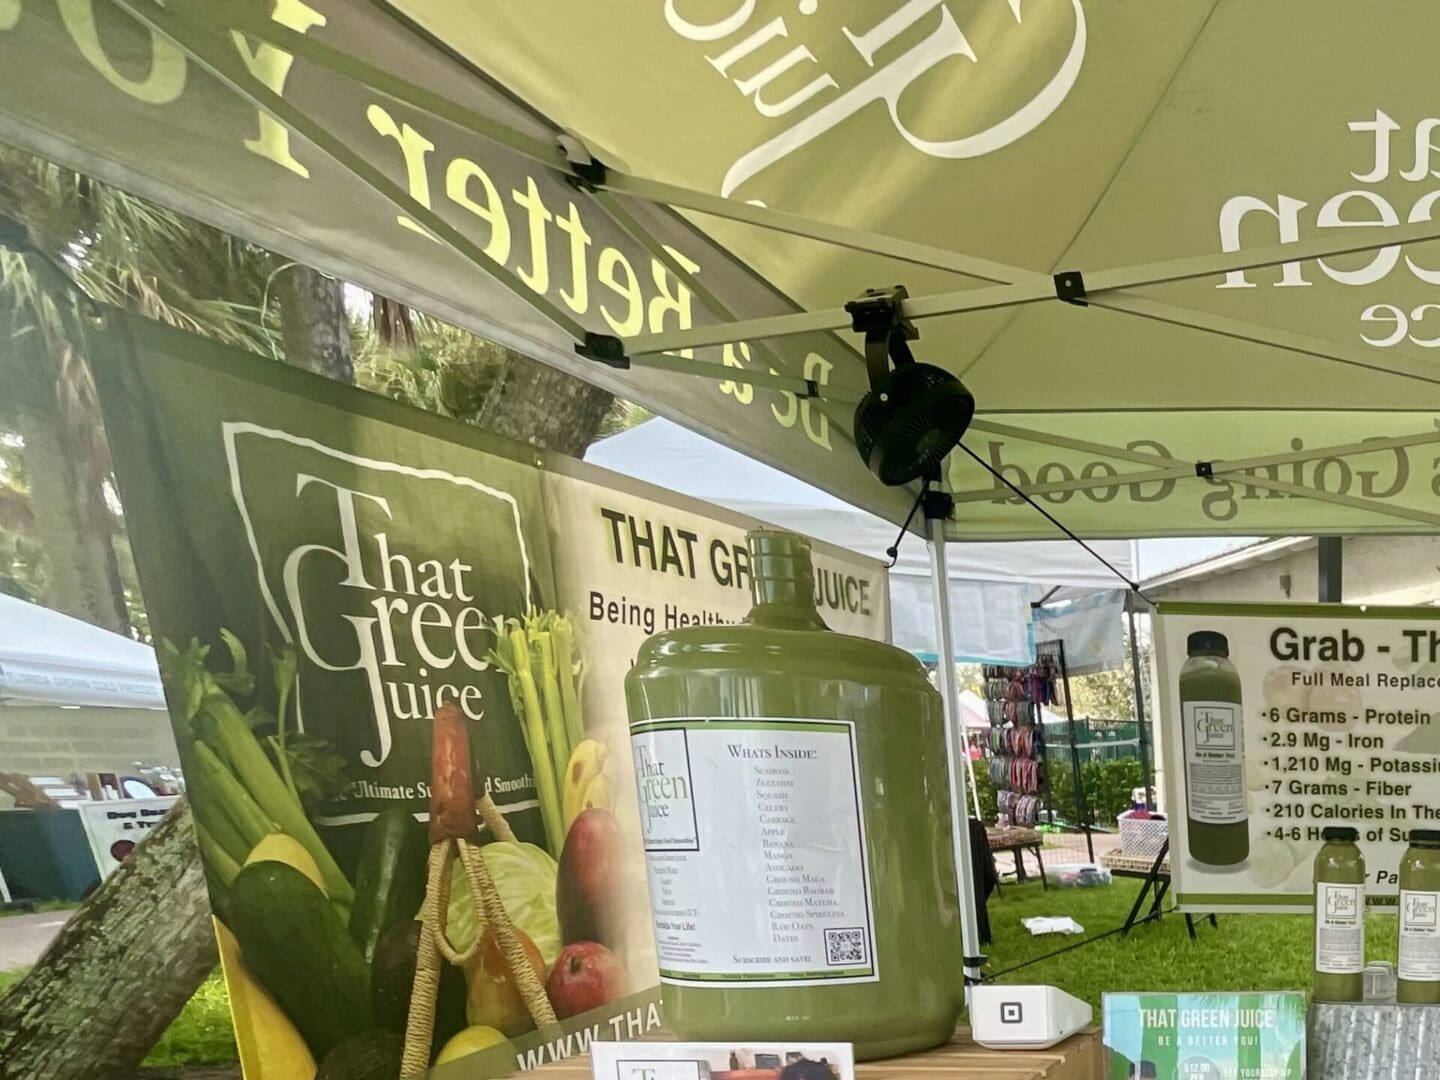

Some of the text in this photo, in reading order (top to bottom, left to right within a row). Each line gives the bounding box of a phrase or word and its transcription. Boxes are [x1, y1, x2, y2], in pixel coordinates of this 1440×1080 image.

[296, 473, 474, 602] That
[601, 507, 698, 579] THAT
[589, 591, 655, 635] Being
[1270, 627, 1364, 662] Grab
[1291, 672, 1324, 687] Full
[1331, 673, 1370, 687] Meal
[360, 614, 485, 768] Juice
[1286, 708, 1347, 724] Grams
[1365, 709, 1431, 726] Protein
[1271, 732, 1384, 751] 2.9 Mg Iron
[1272, 757, 1319, 774] 1,210
[1326, 758, 1352, 775] Mg
[1289, 781, 1348, 796] Grams
[1366, 781, 1412, 796] Fiber
[1274, 804, 1305, 819] 210
[1310, 804, 1384, 820] Calories
[1390, 805, 1407, 820] In
[1274, 827, 1301, 841] 4-6
[1366, 827, 1383, 842] of
